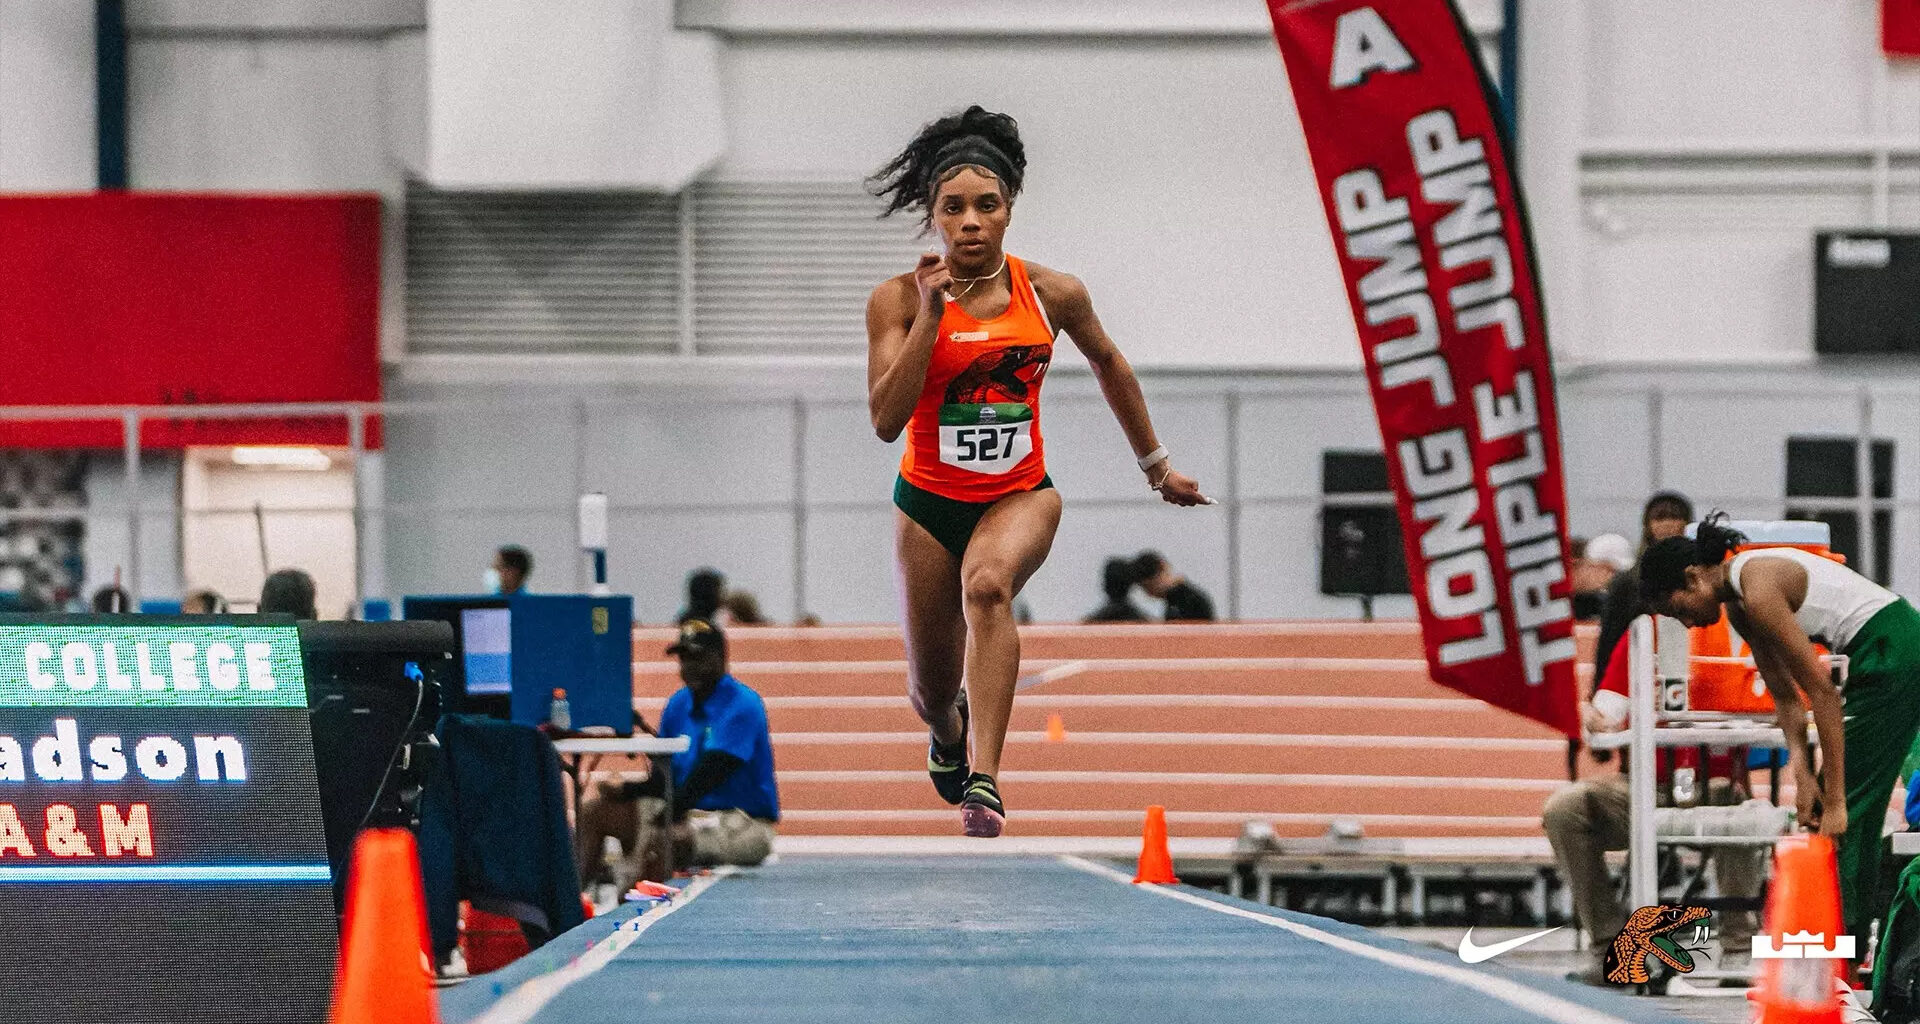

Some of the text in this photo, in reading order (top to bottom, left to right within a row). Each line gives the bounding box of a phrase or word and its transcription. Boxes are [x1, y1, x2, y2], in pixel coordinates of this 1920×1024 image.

[1331, 6, 1415, 88] A
[1333, 167, 1506, 664] LONG JUMP
[1406, 109, 1577, 686] TRIPLE JUMP
[956, 427, 1018, 462] 527
[24, 642, 276, 691] COLLEGE
[0, 802, 154, 857] A&M
